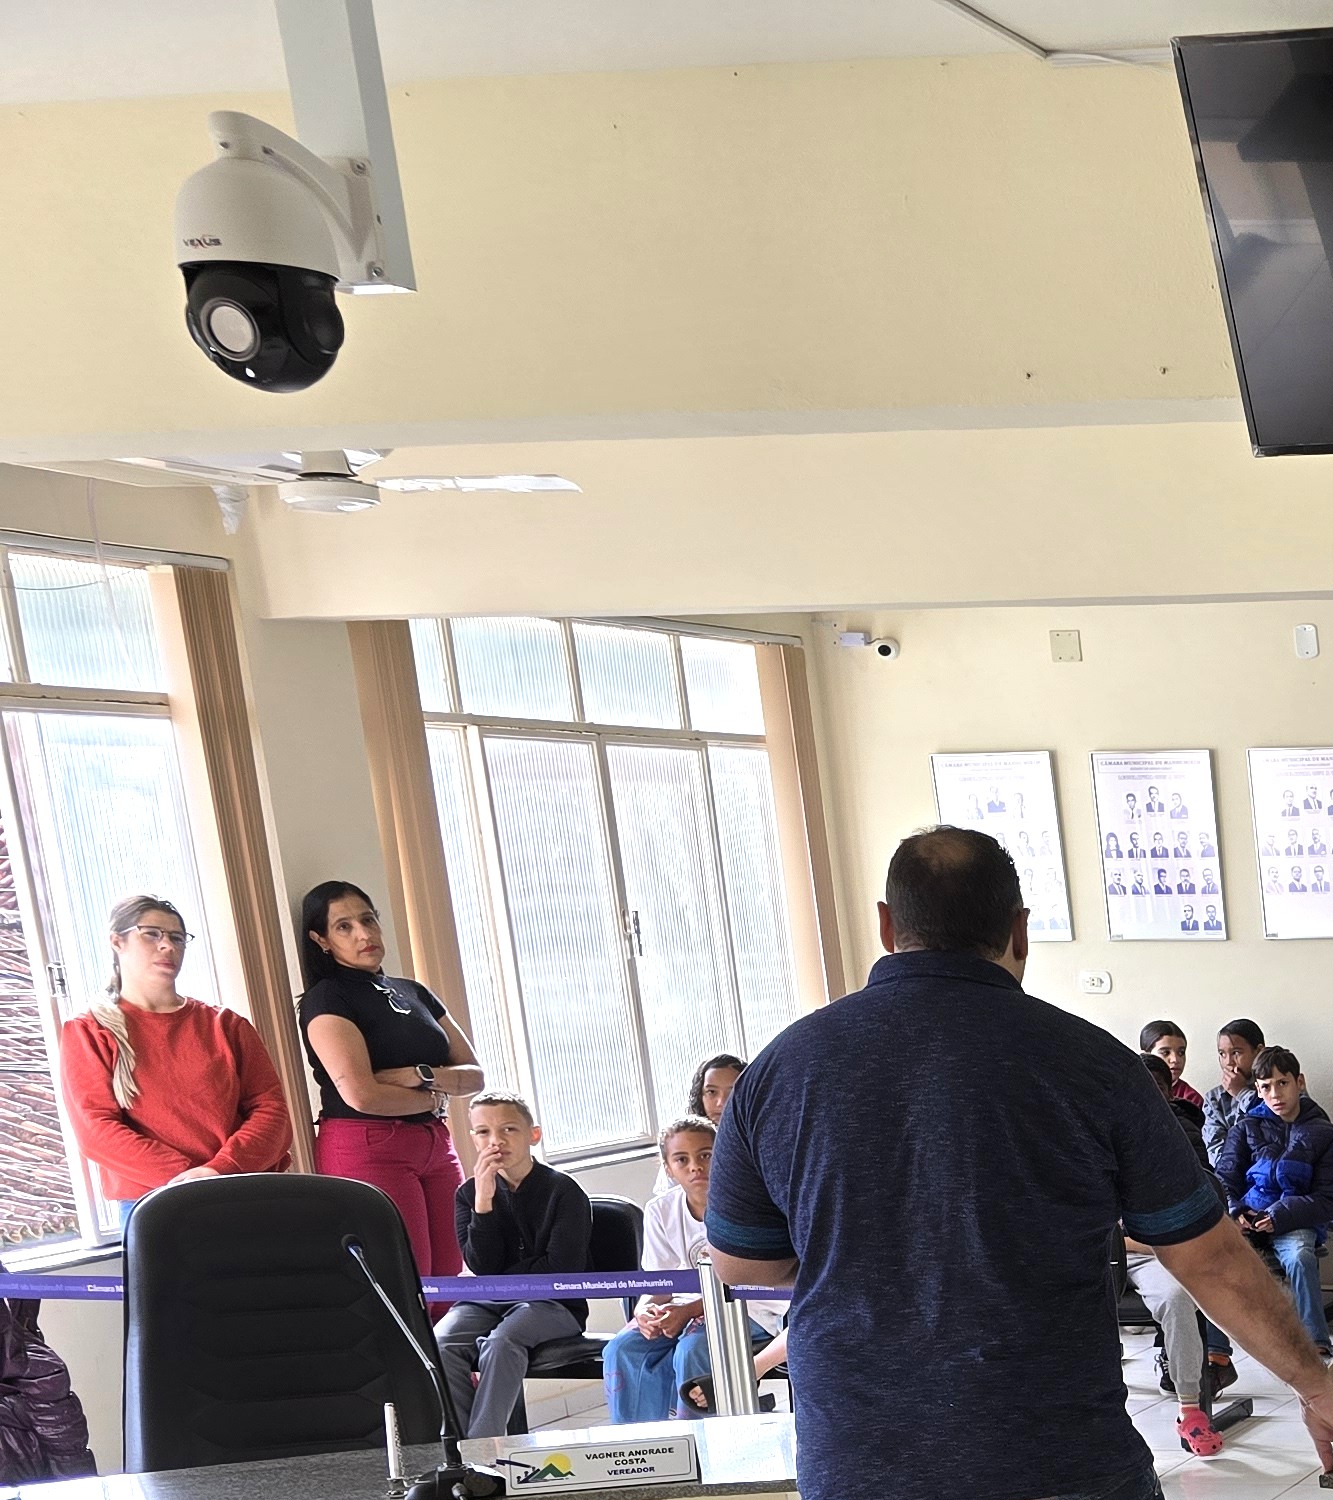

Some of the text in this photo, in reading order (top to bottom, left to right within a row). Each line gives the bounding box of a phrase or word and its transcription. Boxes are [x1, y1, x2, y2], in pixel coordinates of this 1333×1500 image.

[553, 1278, 673, 1291] Câmara Municipal de Manhumirim
[585, 1447, 675, 1460] VAGNER ANDRADE
[614, 1457, 647, 1466] COSTA
[607, 1466, 655, 1476] VEREADOR
